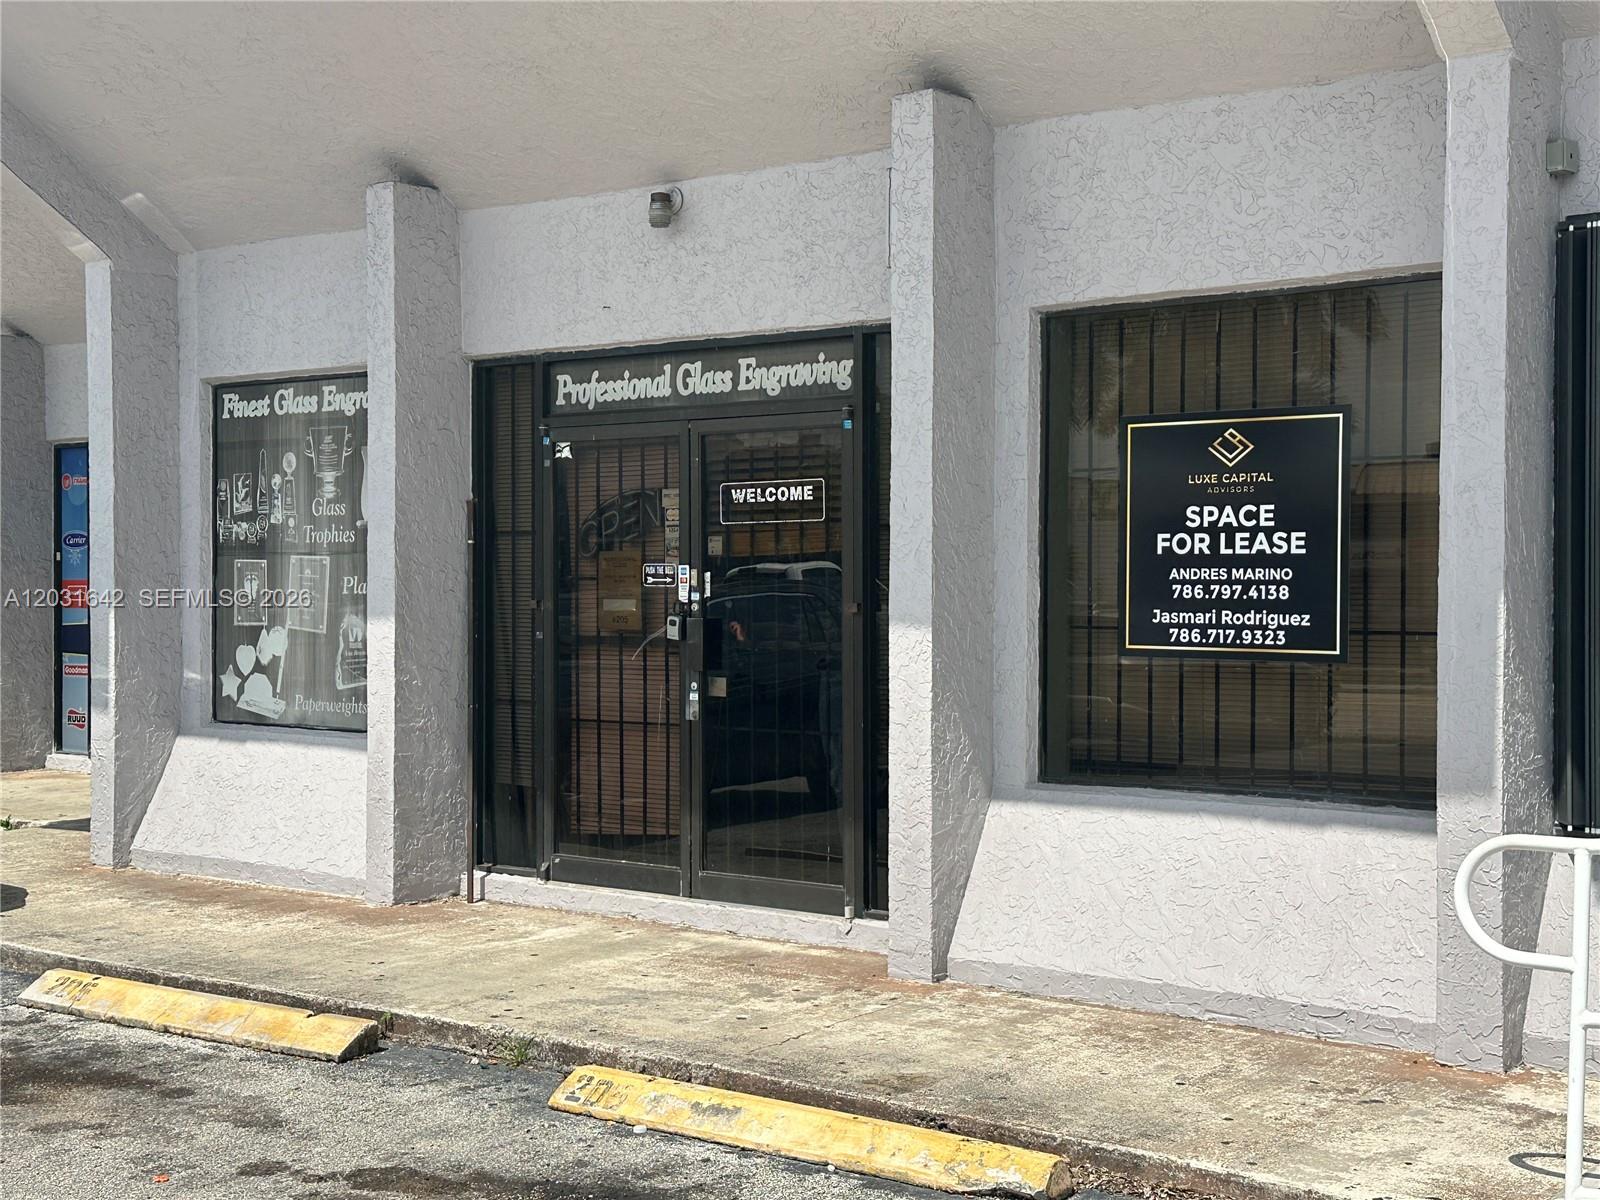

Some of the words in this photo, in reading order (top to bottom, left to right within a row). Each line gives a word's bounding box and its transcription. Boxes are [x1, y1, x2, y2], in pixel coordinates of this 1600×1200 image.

[556, 363, 671, 410] Professional
[676, 361, 733, 398] Glass
[737, 352, 854, 396] Engraving
[222, 393, 271, 419] Finest
[274, 388, 318, 415] Glass
[1188, 474, 1218, 484] LUXE
[1222, 472, 1274, 483] CAPITAL
[731, 485, 814, 503] WELCOME
[1207, 485, 1255, 494] ADVISORS
[312, 497, 346, 516] Glass
[1185, 504, 1275, 528] SPACE
[303, 524, 355, 547] Trophies
[1156, 532, 1211, 555] FOR
[1219, 531, 1307, 555] LEASE
[1169, 567, 1228, 580] ANDRES
[1231, 567, 1293, 580] MARINO
[1172, 584, 1290, 600] 786.797.4138
[1152, 609, 1216, 625] Jasmari
[1221, 610, 1311, 629] Rodriguez
[1169, 628, 1286, 645] 786.717.9323
[295, 694, 367, 716] Paperweights
[67, 715, 86, 723] RUUD
